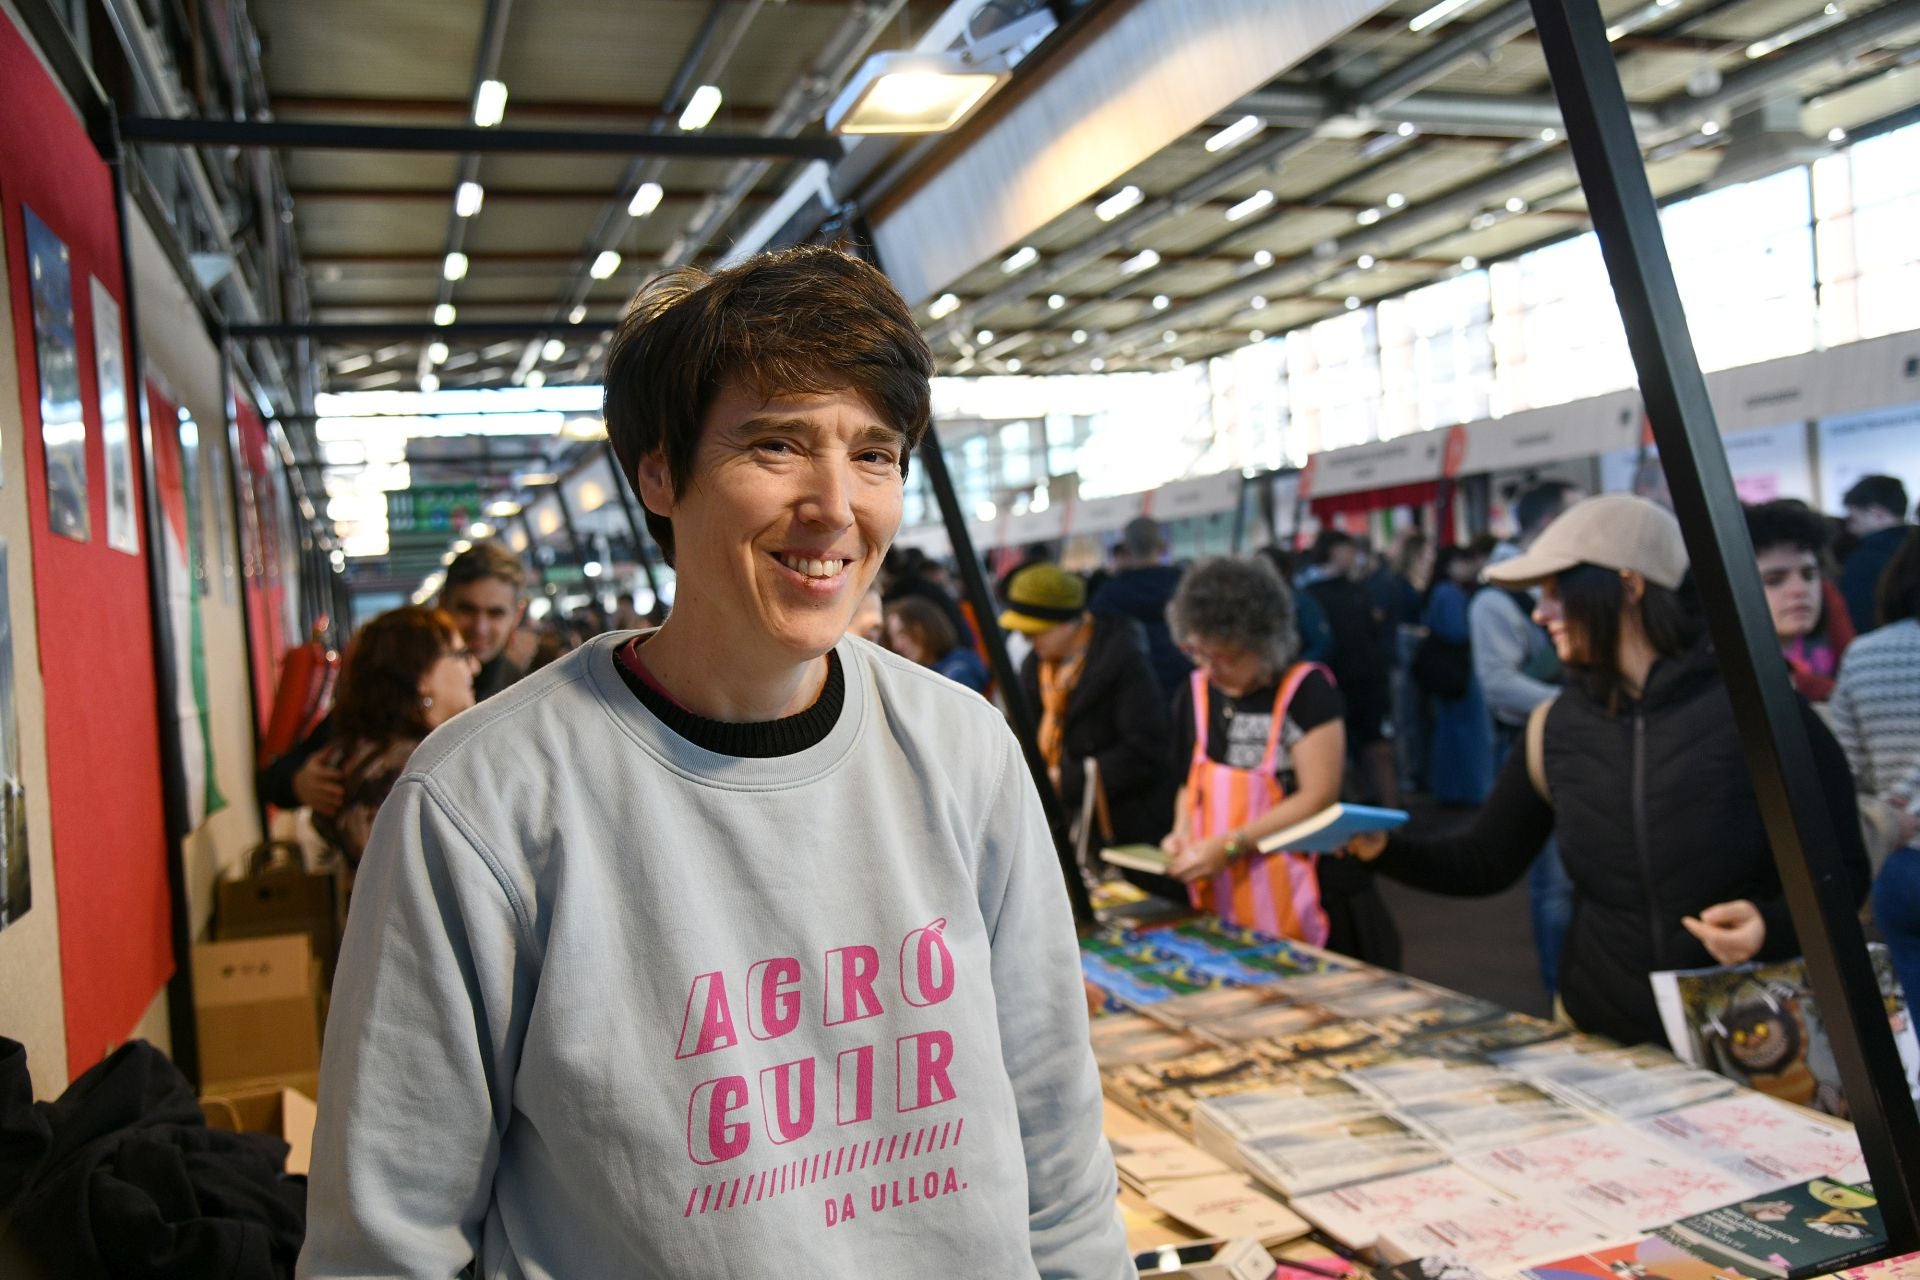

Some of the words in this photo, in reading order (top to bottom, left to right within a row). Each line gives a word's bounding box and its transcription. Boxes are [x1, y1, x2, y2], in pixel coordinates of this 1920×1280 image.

[686, 1030, 957, 1166] CUIR
[824, 1193, 856, 1228] DA
[871, 1167, 968, 1212] ULLOA.
